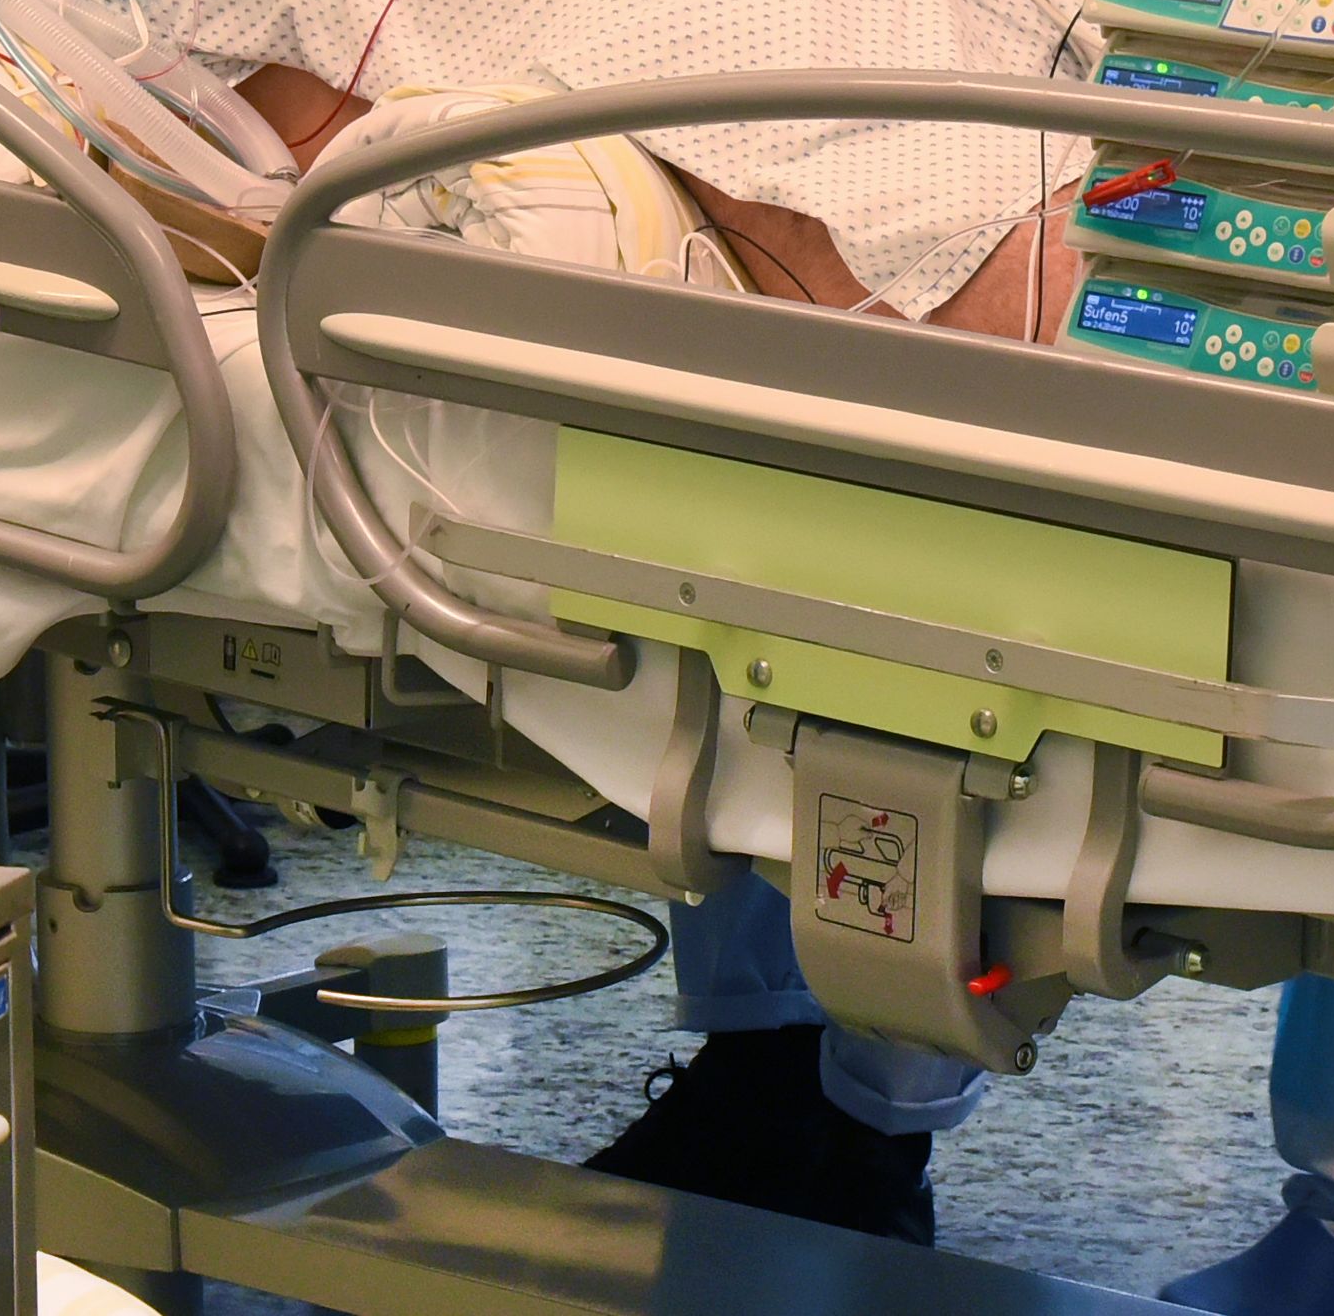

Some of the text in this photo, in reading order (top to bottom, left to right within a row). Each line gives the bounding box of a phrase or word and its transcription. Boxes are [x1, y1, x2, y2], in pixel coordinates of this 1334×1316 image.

[1181, 206, 1199, 221] 10
[1083, 304, 1191, 336] Sufen5 10
